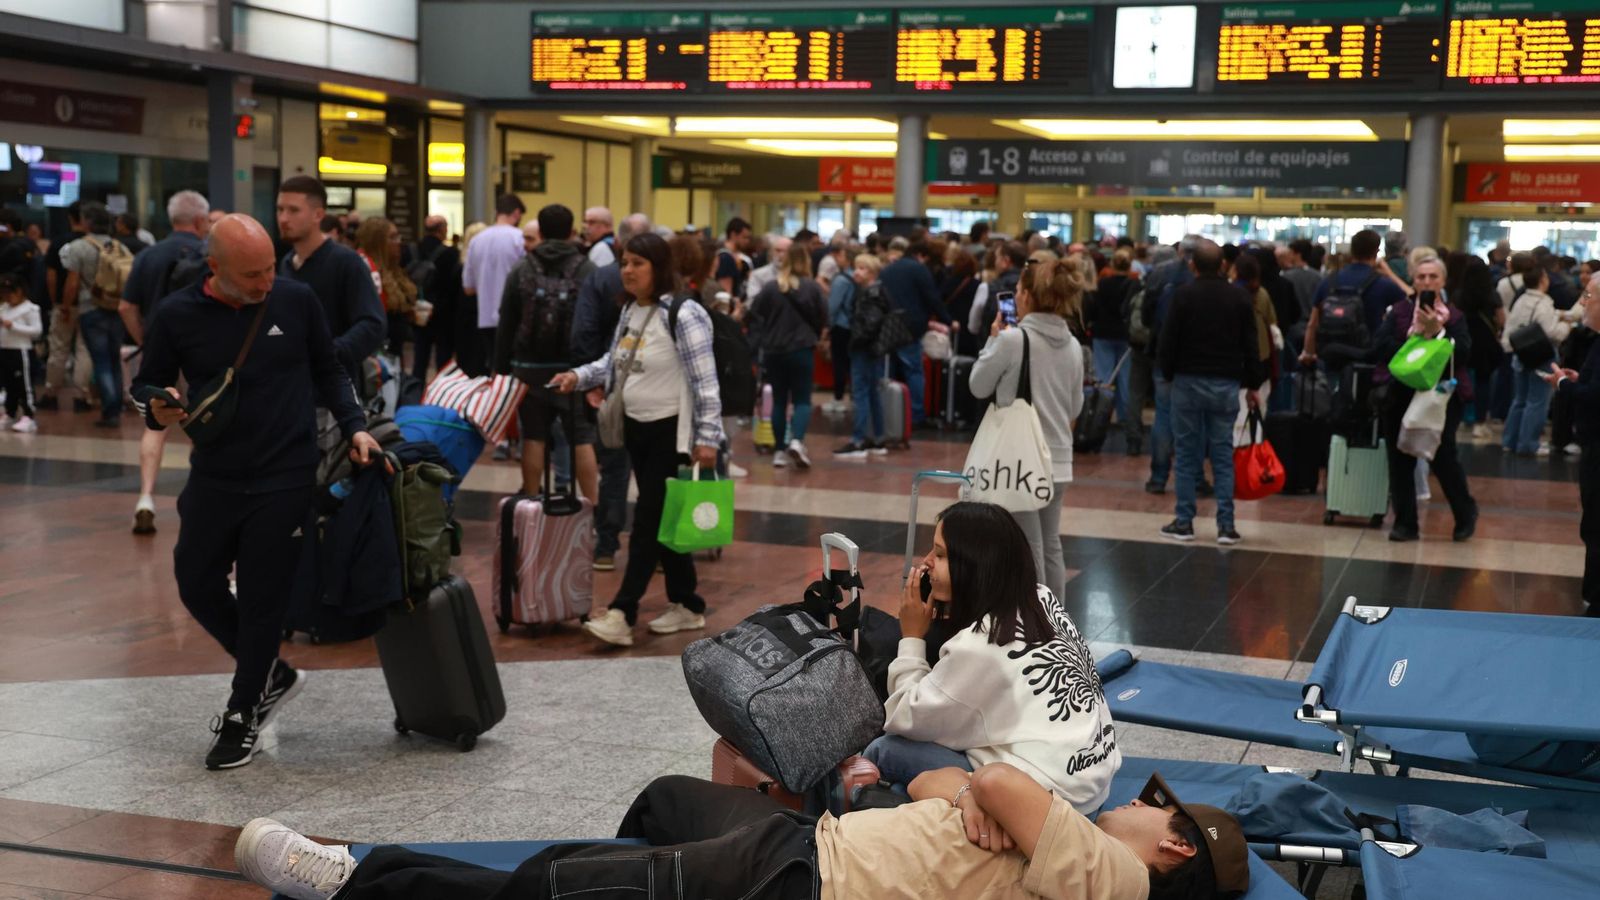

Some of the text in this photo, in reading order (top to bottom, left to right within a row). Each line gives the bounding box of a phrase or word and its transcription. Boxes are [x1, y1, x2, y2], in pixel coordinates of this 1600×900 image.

[979, 147, 1020, 176] 1-8
[1028, 147, 1127, 163] Acceso a vías
[1182, 149, 1350, 168] Control de equipajes
[852, 163, 868, 176] No
[1028, 166, 1086, 177] PLATFORMS
[1233, 168, 1281, 178] CONTROL
[1509, 171, 1580, 187] No pasar
